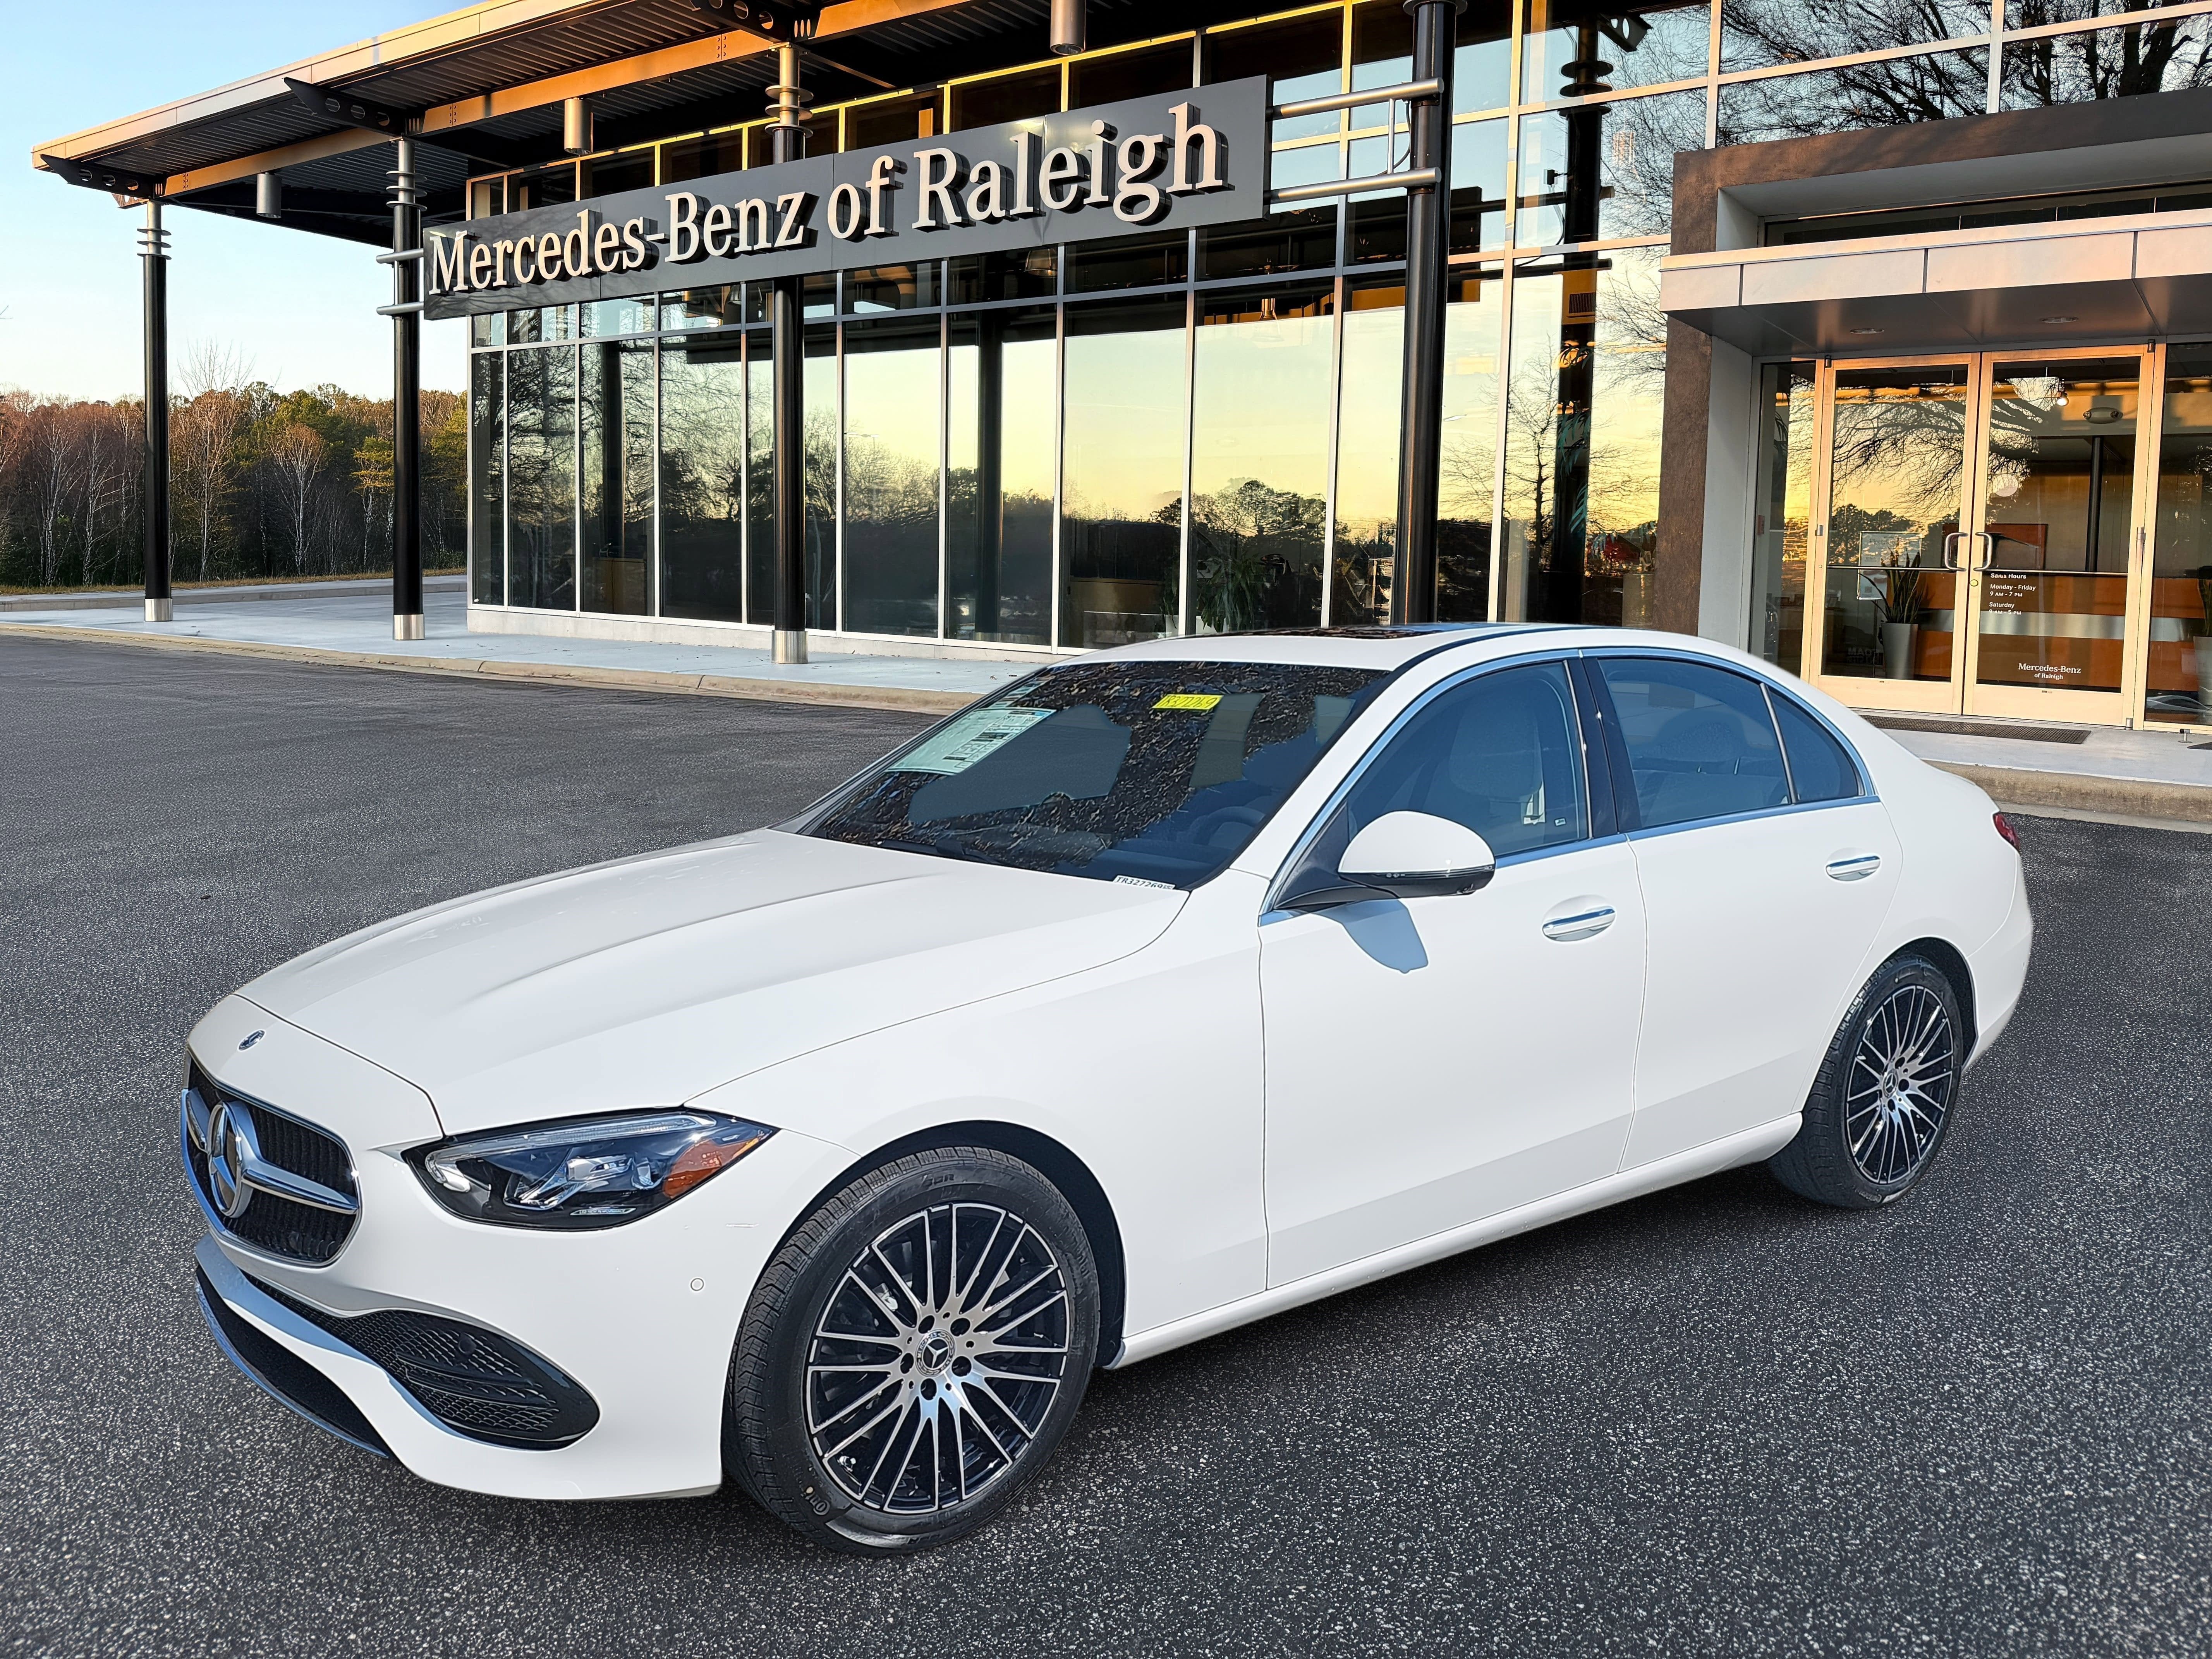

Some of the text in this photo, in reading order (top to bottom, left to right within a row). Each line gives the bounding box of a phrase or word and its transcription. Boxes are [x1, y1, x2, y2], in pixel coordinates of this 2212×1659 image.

[429, 101, 1224, 295] Mercedes-Benz of Raleigh
[2018, 663, 2081, 674] Mercedes-Benz
